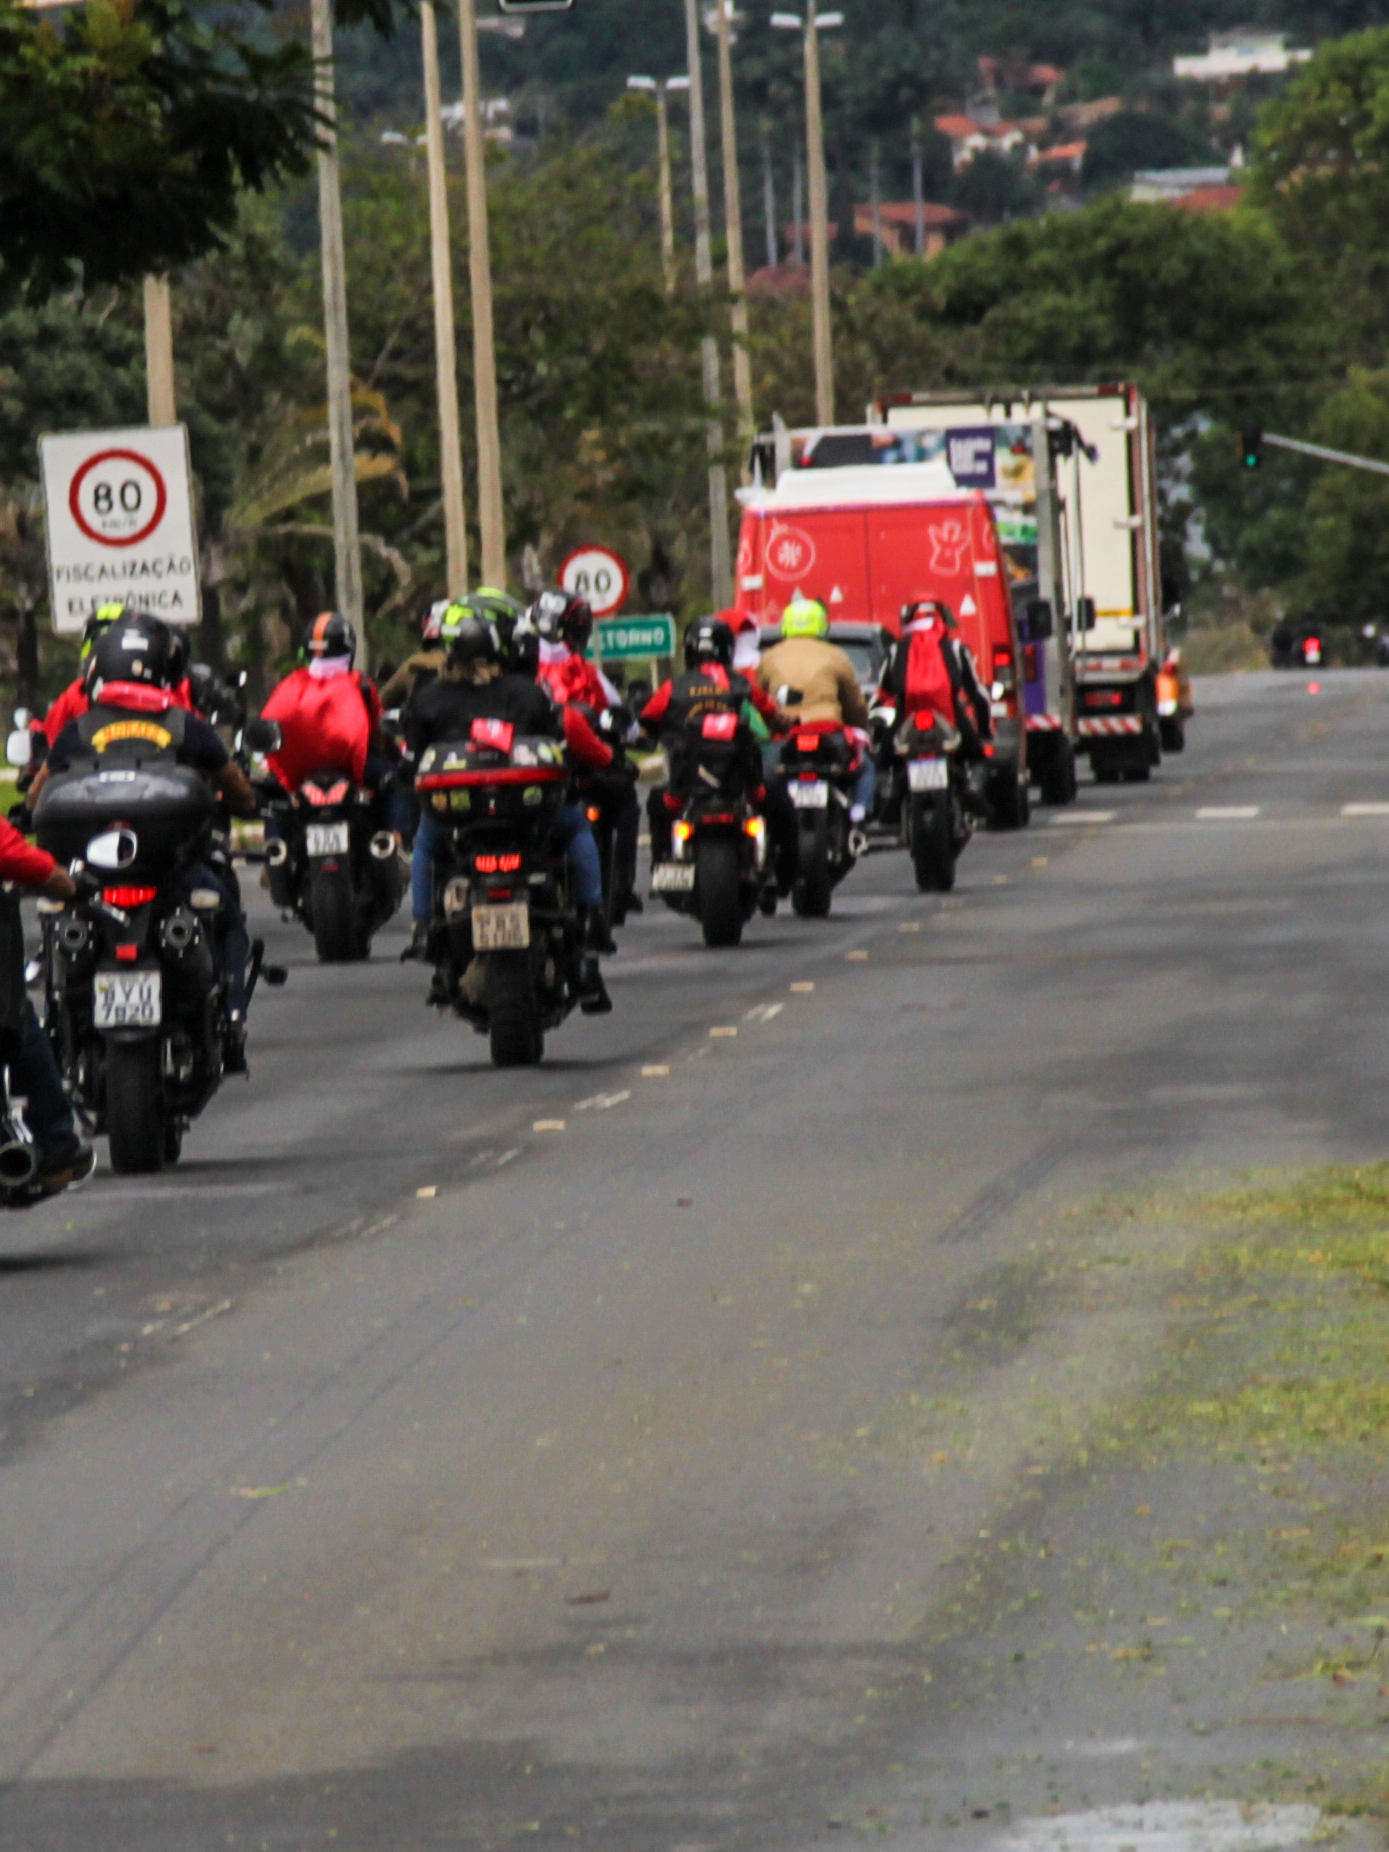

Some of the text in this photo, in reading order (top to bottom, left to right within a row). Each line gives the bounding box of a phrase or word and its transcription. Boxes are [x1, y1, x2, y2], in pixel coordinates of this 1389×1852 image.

[93, 479, 142, 515] 80
[55, 552, 192, 583] FISCALIZAÇÃO
[575, 569, 612, 594] 80
